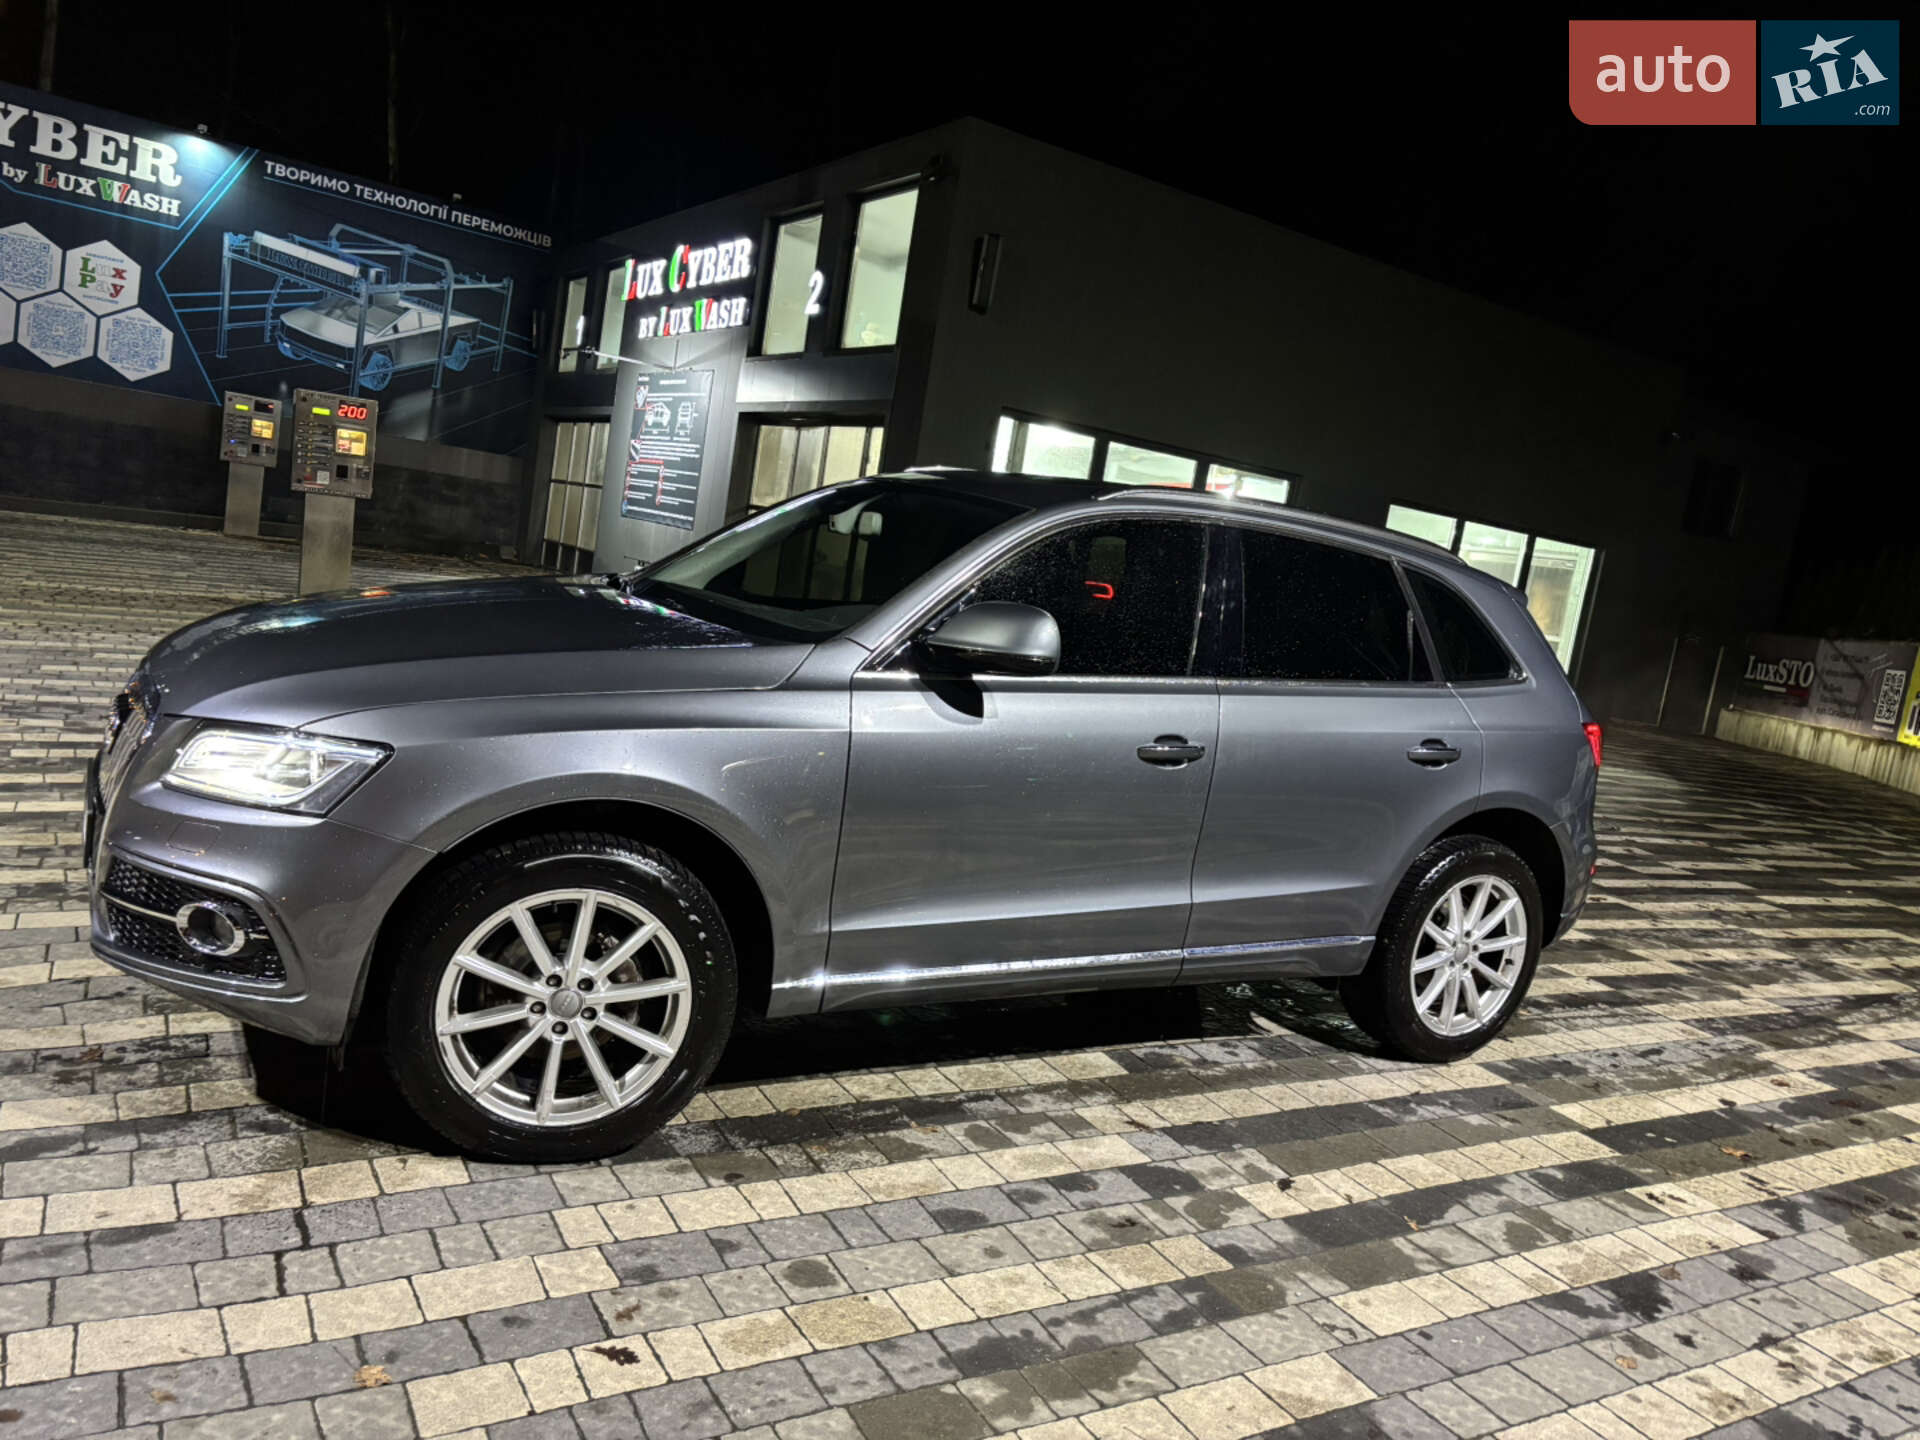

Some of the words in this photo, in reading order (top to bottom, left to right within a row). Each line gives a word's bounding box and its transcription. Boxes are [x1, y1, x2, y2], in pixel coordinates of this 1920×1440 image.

[2, 161, 28, 183] by
[264, 160, 350, 193] ТВОРИМО
[353, 183, 448, 220] ТЕХНОЛОГІЇ
[451, 210, 552, 247] ПЕРЕМОЖЦІВ
[669, 237, 753, 292] CYBER
[805, 270, 824, 315] 2
[338, 404, 368, 420] 200
[1744, 655, 1815, 688] LuxSTO
